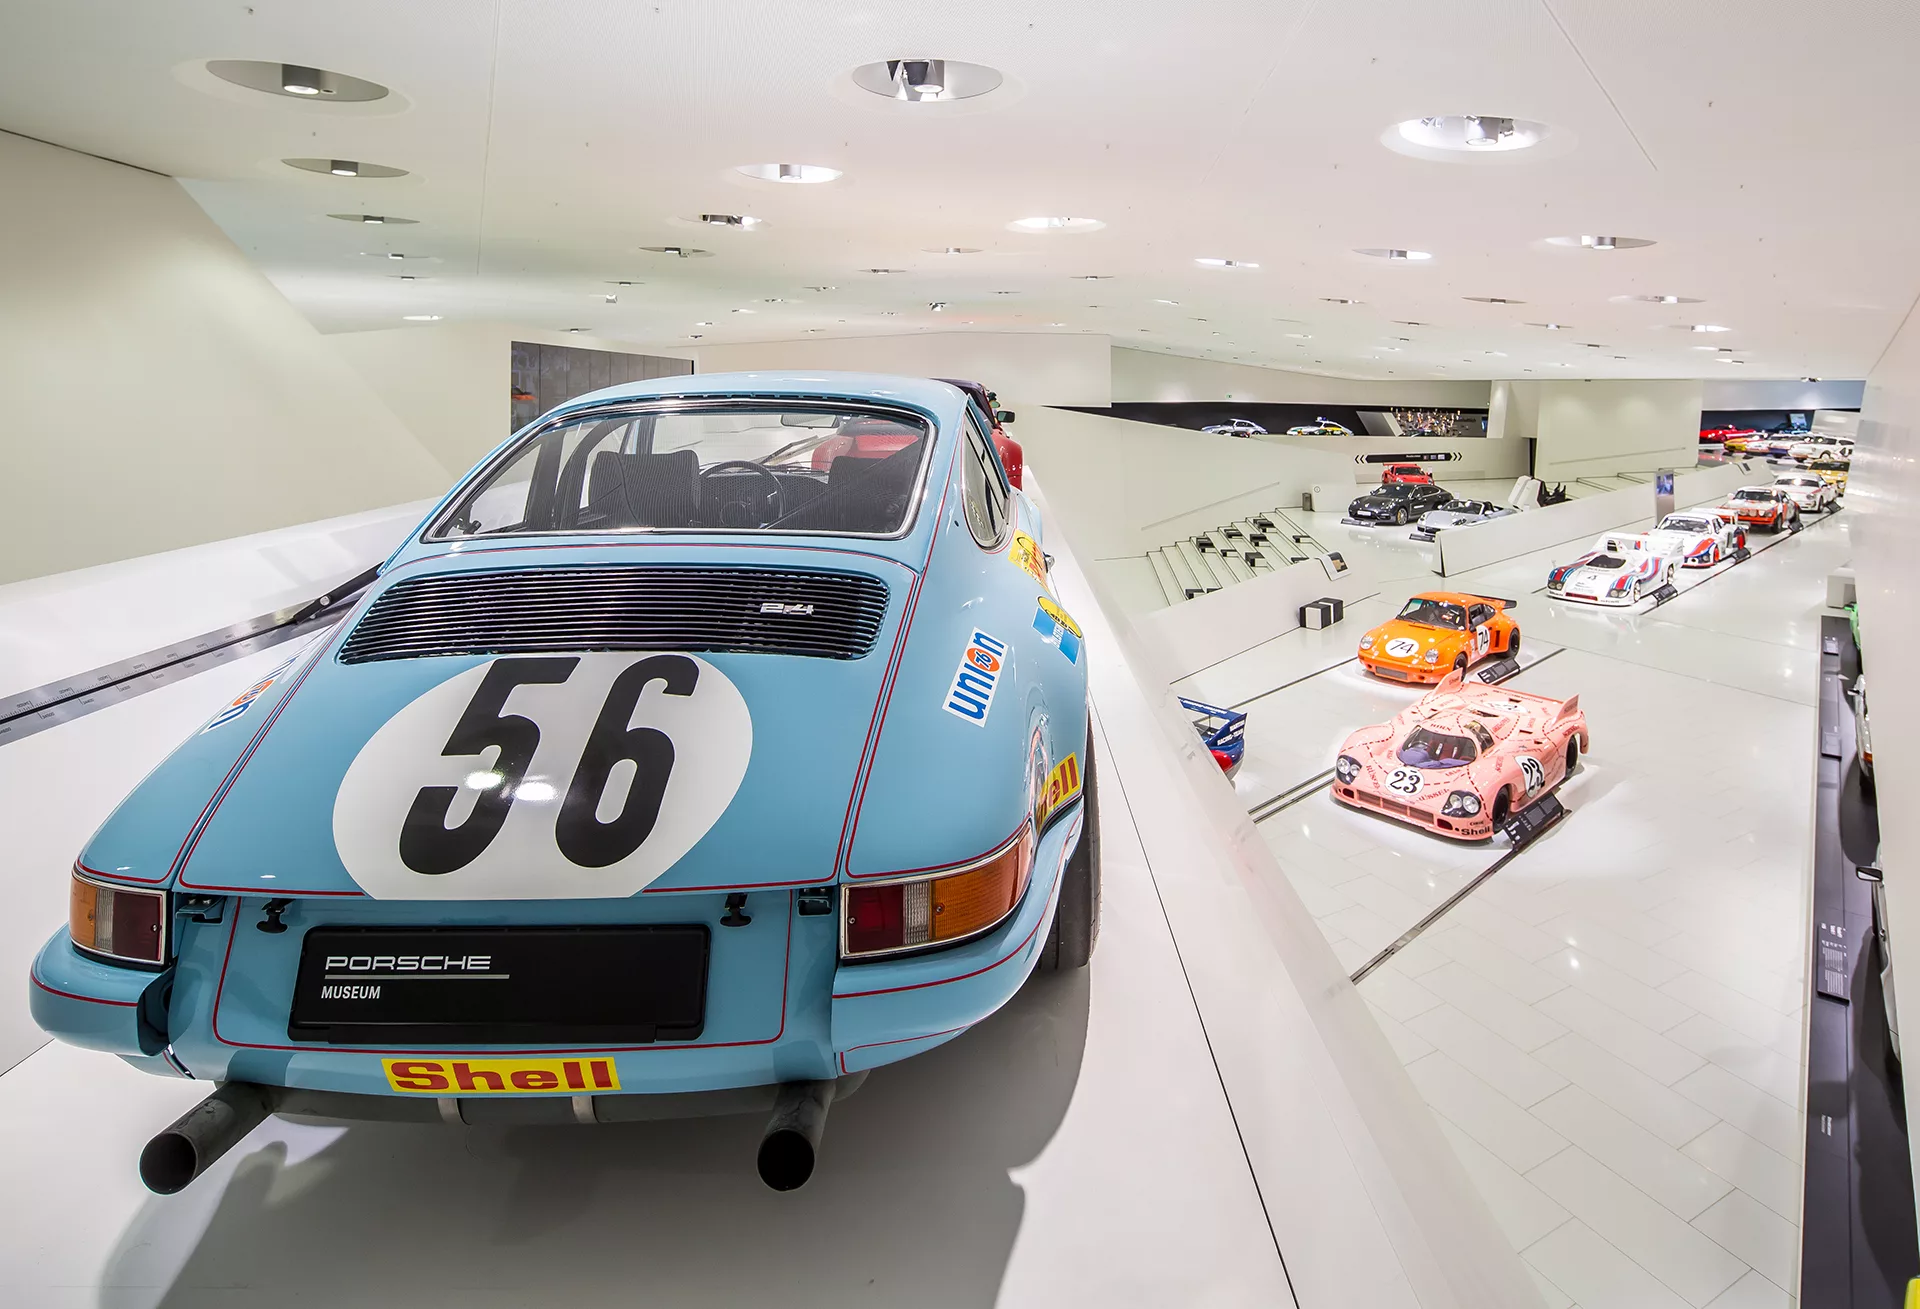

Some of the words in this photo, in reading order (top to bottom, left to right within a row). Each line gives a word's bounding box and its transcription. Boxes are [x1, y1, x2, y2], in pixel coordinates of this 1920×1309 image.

[760, 603, 814, 615] 2.4
[1390, 640, 1414, 654] 74
[1478, 630, 1489, 651] 74
[399, 654, 700, 876] 56
[1390, 770, 1421, 794] 23
[1521, 757, 1545, 793] 23
[1461, 825, 1490, 837] Shell
[325, 956, 491, 970] PORSCHE
[321, 986, 381, 999] MUSEUM
[390, 1060, 613, 1090] Shell
